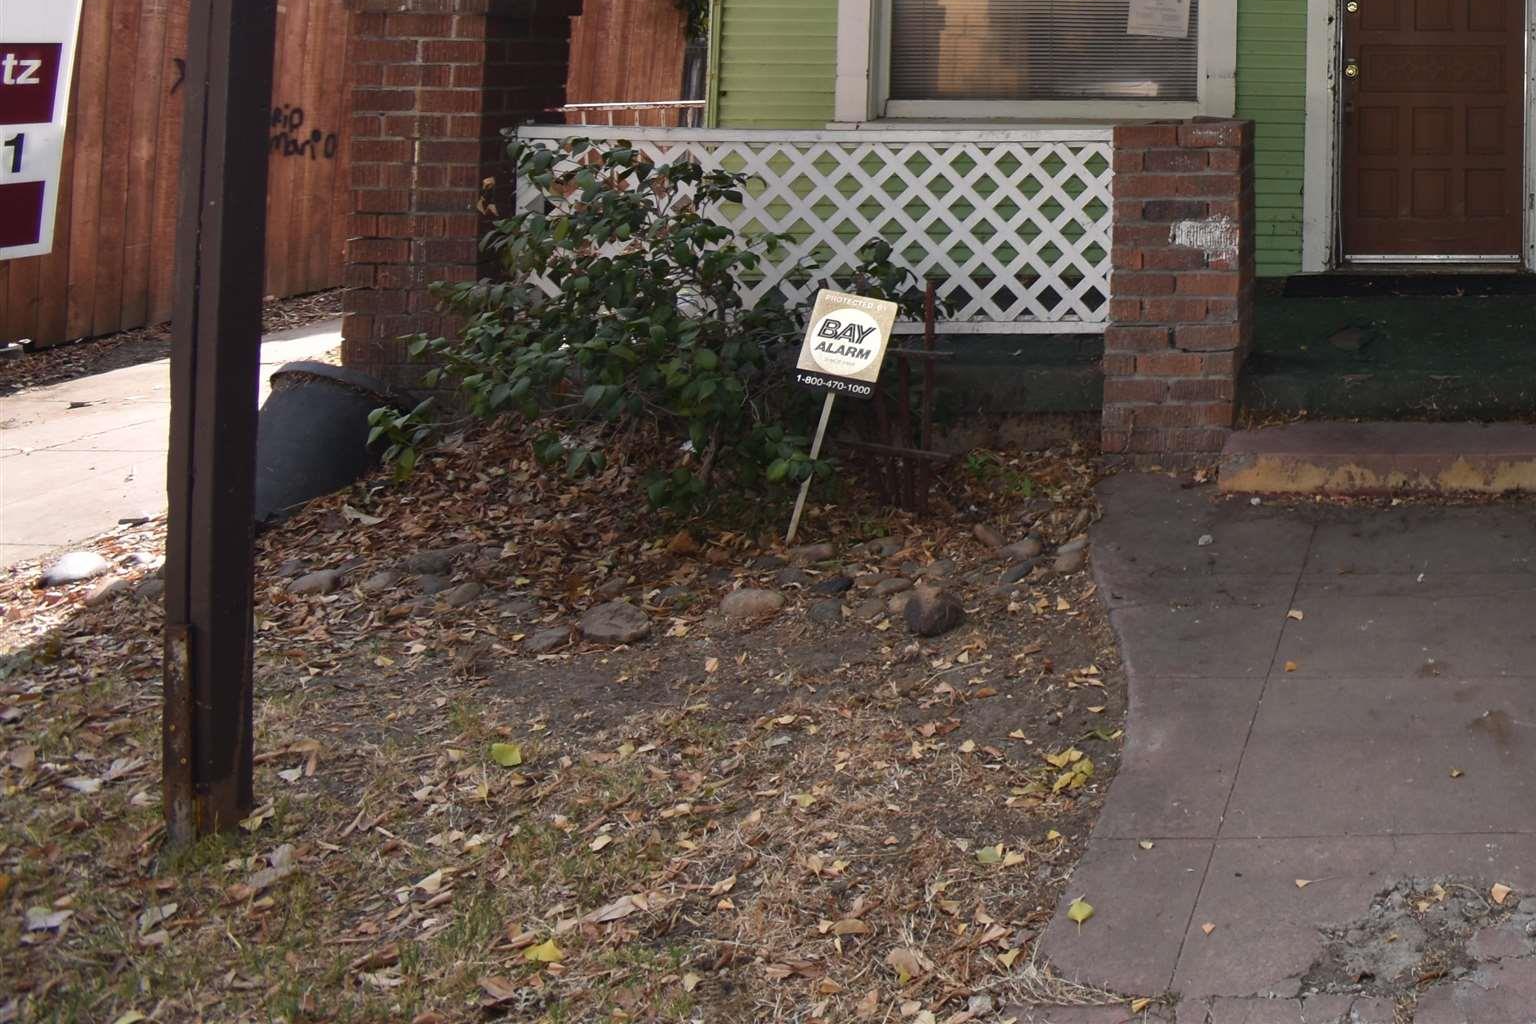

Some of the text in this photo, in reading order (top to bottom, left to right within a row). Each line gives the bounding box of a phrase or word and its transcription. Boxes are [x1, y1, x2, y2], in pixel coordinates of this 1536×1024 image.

[824, 294, 874, 309] PROTECTED
[817, 319, 876, 344] BAY
[815, 341, 872, 360] ALARM
[796, 374, 871, 395] 1-800-470-1000
